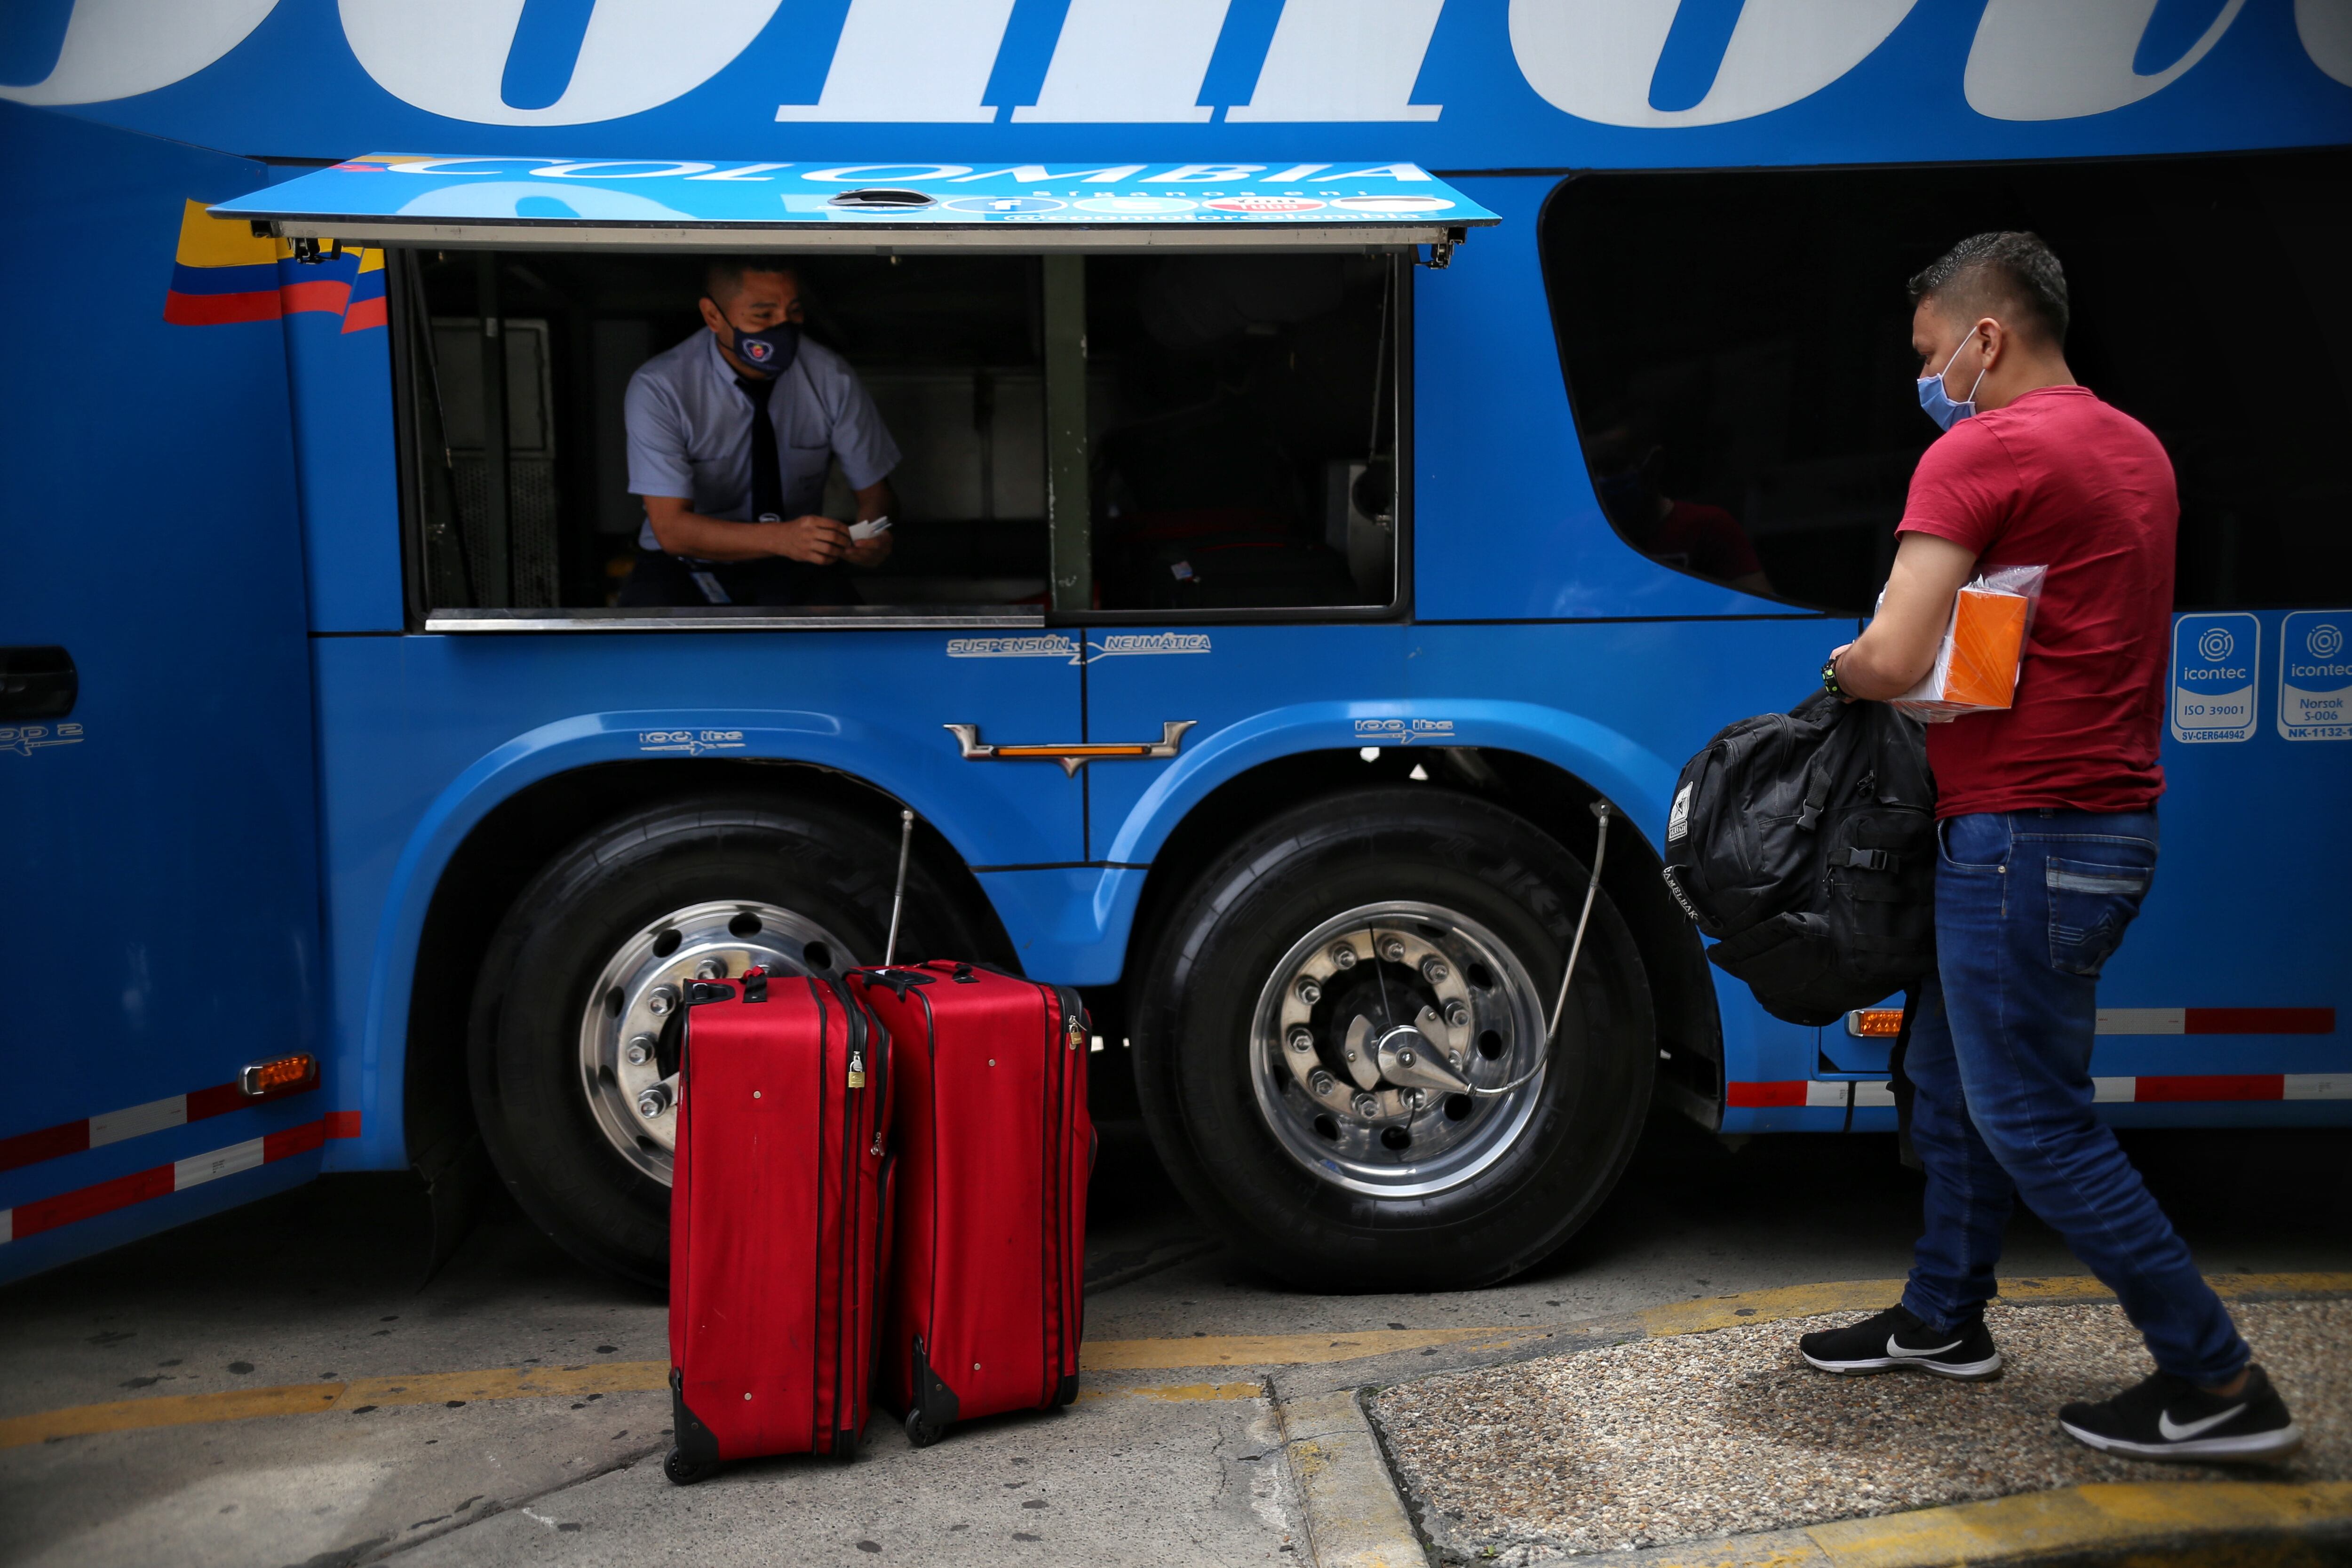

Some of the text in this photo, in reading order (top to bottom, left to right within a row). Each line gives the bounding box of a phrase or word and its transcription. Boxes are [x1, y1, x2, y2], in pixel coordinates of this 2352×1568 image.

[387, 158, 1433, 183] COLOMBIA
[946, 632, 1212, 653] SUSPENSIÓN NEUMÁTICA
[2184, 667, 2247, 680] icontec
[2291, 663, 2352, 677] icontec
[2300, 698, 2344, 709] Norsok
[2184, 705, 2244, 716] ISO 39001
[2305, 711, 2338, 721] S-006
[2182, 730, 2245, 740] SV-CER644942
